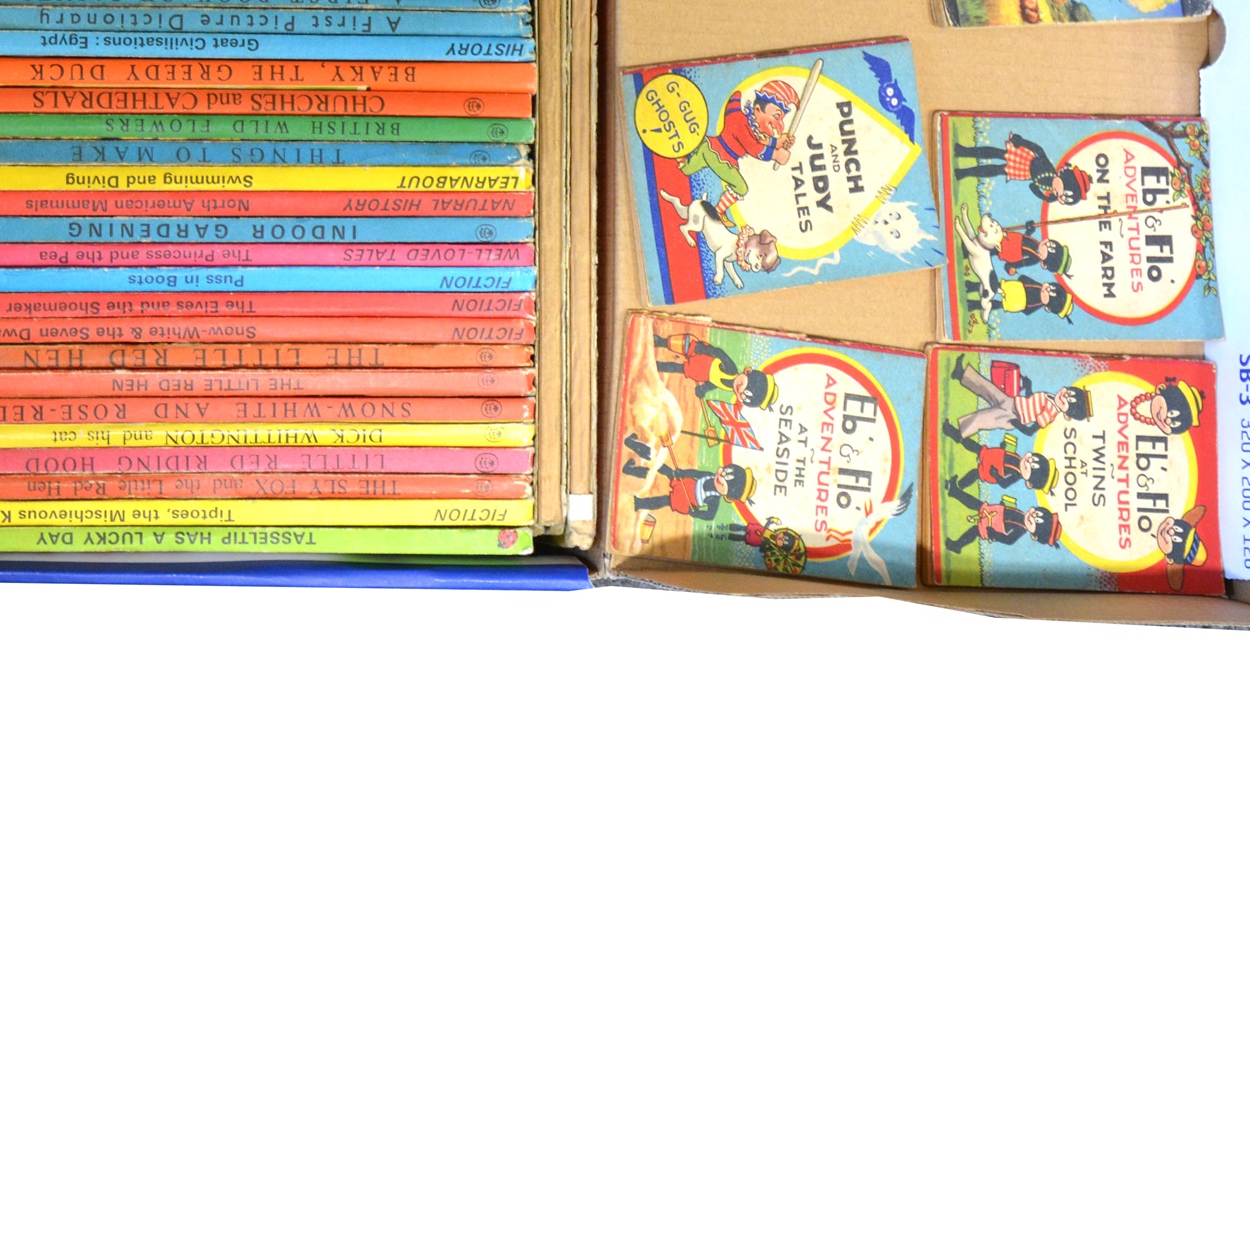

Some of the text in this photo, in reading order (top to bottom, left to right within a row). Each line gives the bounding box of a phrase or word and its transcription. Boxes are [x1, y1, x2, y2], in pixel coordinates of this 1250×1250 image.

[40, 33, 260, 52] Great Civilisations: Egypt
[445, 42, 525, 57] HISTORY
[29, 62, 417, 83] BEAKY, THE GREEDY DUCK
[32, 90, 386, 114] CHURCHES and CATHEDRALS
[105, 117, 401, 137] BRITISH WILD FLOWERS
[836, 101, 864, 194] PUNCH
[830, 144, 840, 172] AND
[65, 172, 254, 189] Swimming and Diving
[396, 175, 520, 190] LEARNABOUT
[806, 135, 834, 214] JUDY
[791, 162, 812, 233] TALES
[68, 221, 357, 241] INDOOR GARDENING
[342, 247, 520, 262] WELL-LOVED TALES
[127, 274, 245, 288] Puss in Boots
[439, 275, 513, 290] FICTION
[39, 326, 90, 341] Seven
[95, 326, 125, 340] the
[130, 326, 143, 340] &
[148, 325, 257, 340] Snow-White
[450, 326, 525, 341] FICTION
[111, 377, 304, 392] THE LITTLE RED HEN
[153, 402, 210, 420] AND
[235, 401, 412, 419] SNOW-WHITE
[774, 404, 793, 496] SEASIDE
[794, 423, 808, 488] AT THE
[814, 373, 837, 533] ADVENTURES
[840, 444, 859, 463] &
[1064, 427, 1077, 512] SCHOOL
[1079, 460, 1088, 477] AT
[1092, 430, 1106, 507] TWINS
[1117, 394, 1131, 549] ADVENTURES
[1137, 473, 1154, 492] &
[18, 509, 126, 523] Mischievous
[131, 509, 160, 523] the
[167, 506, 235, 523] Tiptoes,
[433, 508, 508, 522] FICTION
[36, 530, 317, 546] TASSELTIP HAS A LUCKY DAY
